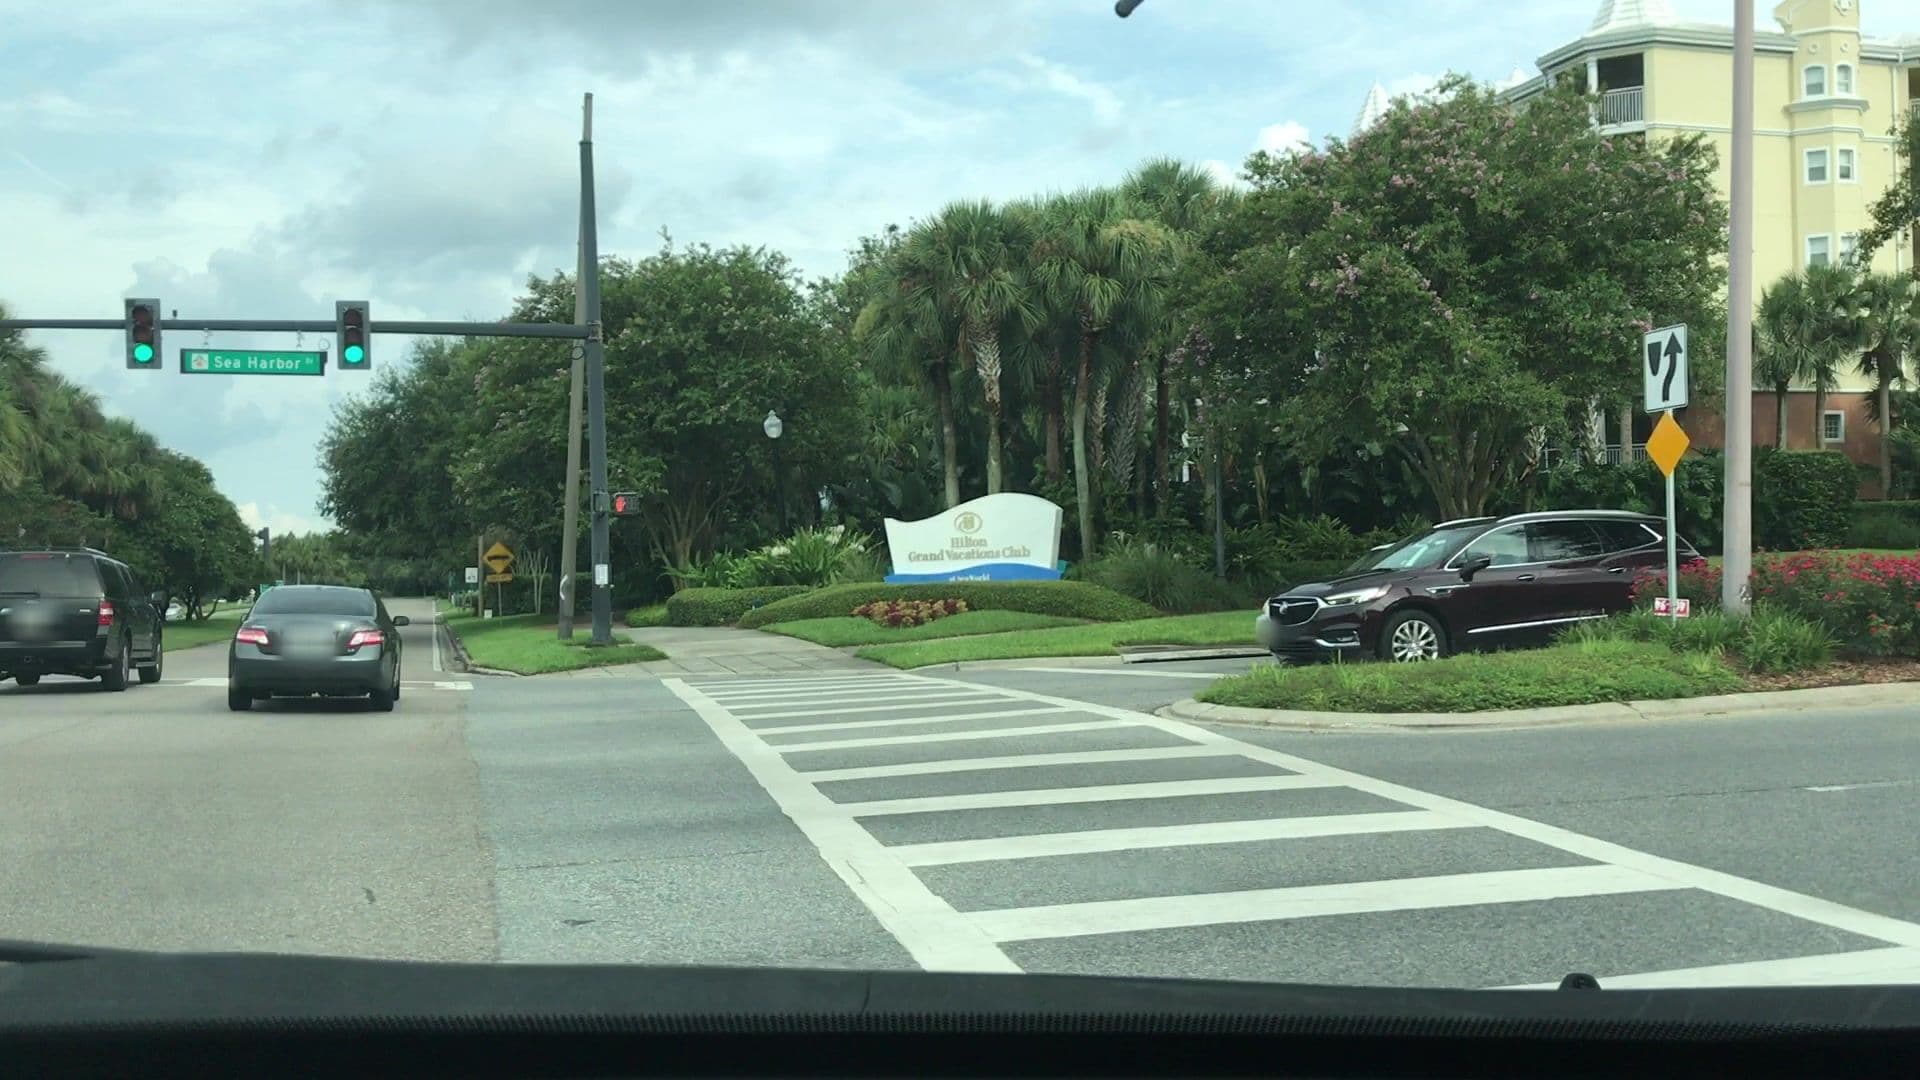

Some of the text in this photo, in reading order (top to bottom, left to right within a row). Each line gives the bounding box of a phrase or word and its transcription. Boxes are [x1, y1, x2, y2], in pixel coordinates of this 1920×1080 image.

[214, 356, 241, 369] Sea
[247, 356, 301, 370] Harbor
[951, 536, 987, 547] Hilton
[908, 546, 1031, 561] Grand Vacations Club
